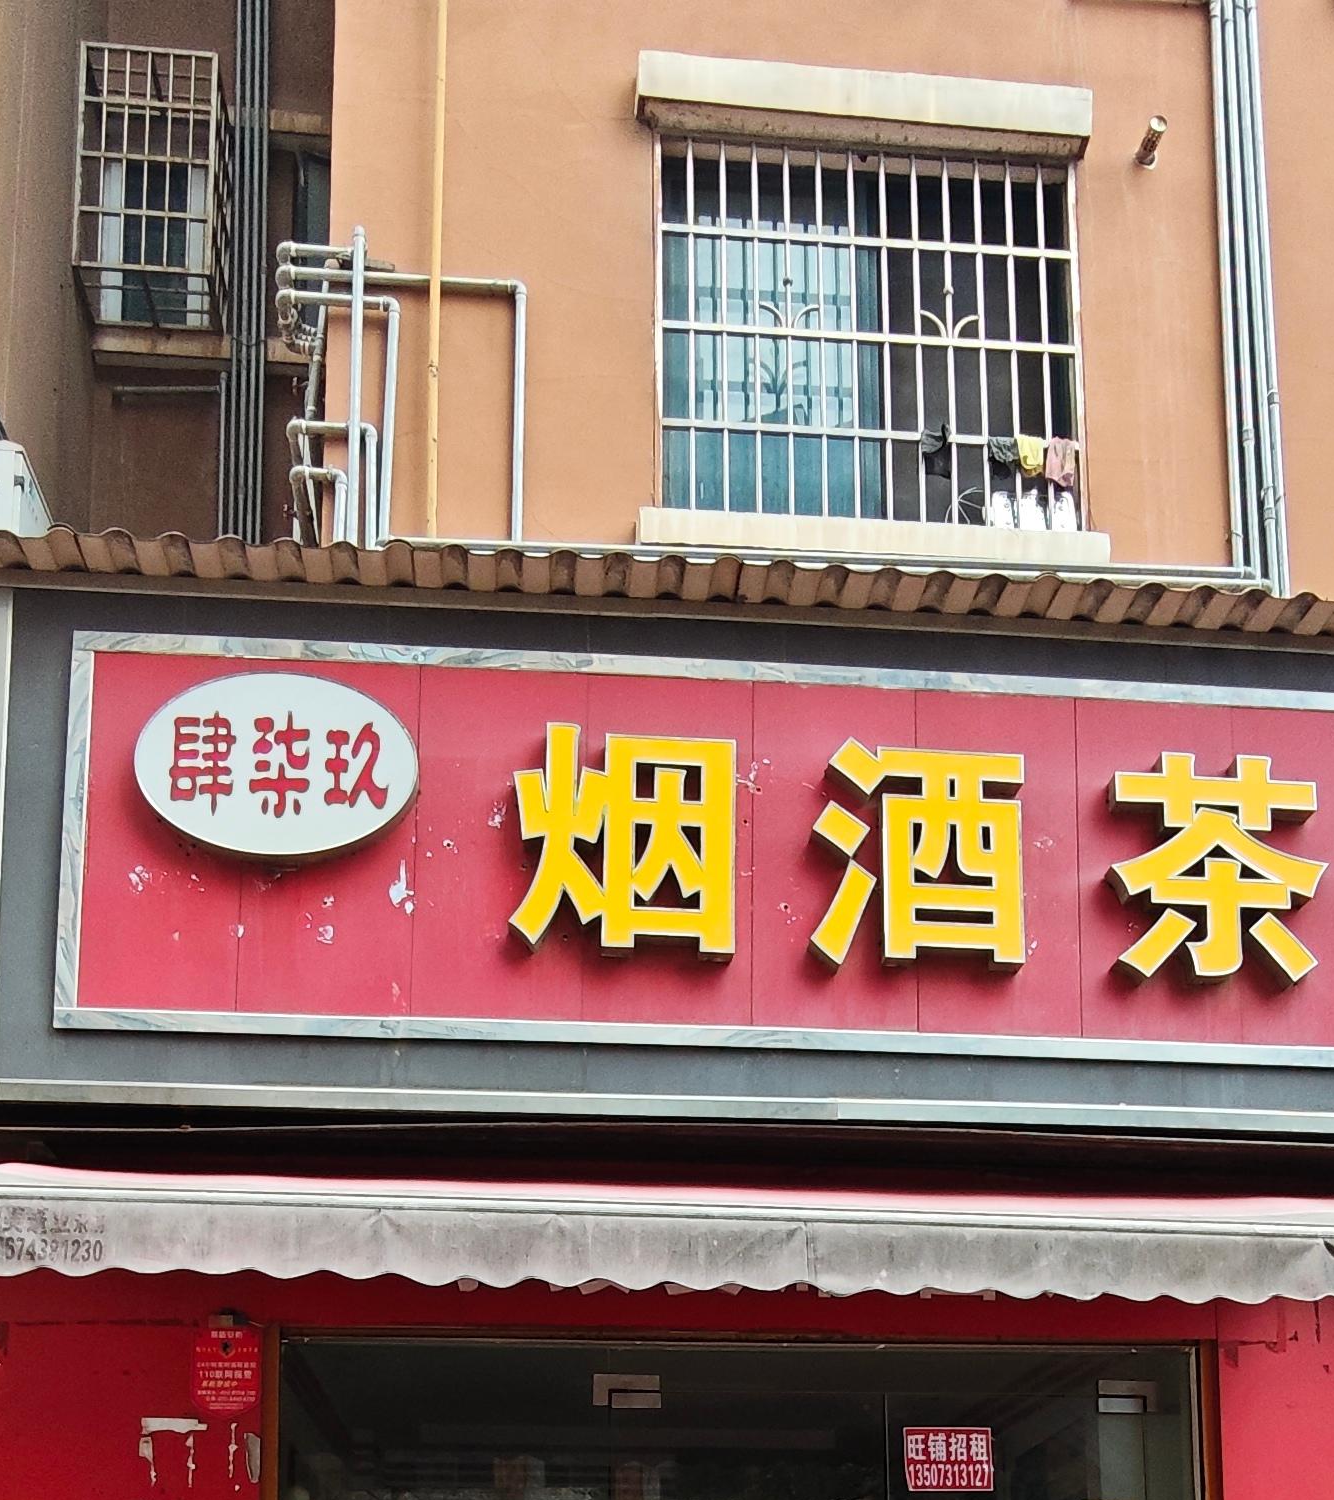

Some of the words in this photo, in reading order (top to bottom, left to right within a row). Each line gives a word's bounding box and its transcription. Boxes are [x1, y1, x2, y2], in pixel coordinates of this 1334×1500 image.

[168, 711, 389, 818] 肆柒玖
[508, 721, 1329, 984] 烟酒茶
[907, 1432, 989, 1462] 旺铺招租
[908, 1463, 989, 1487] 13507313127
